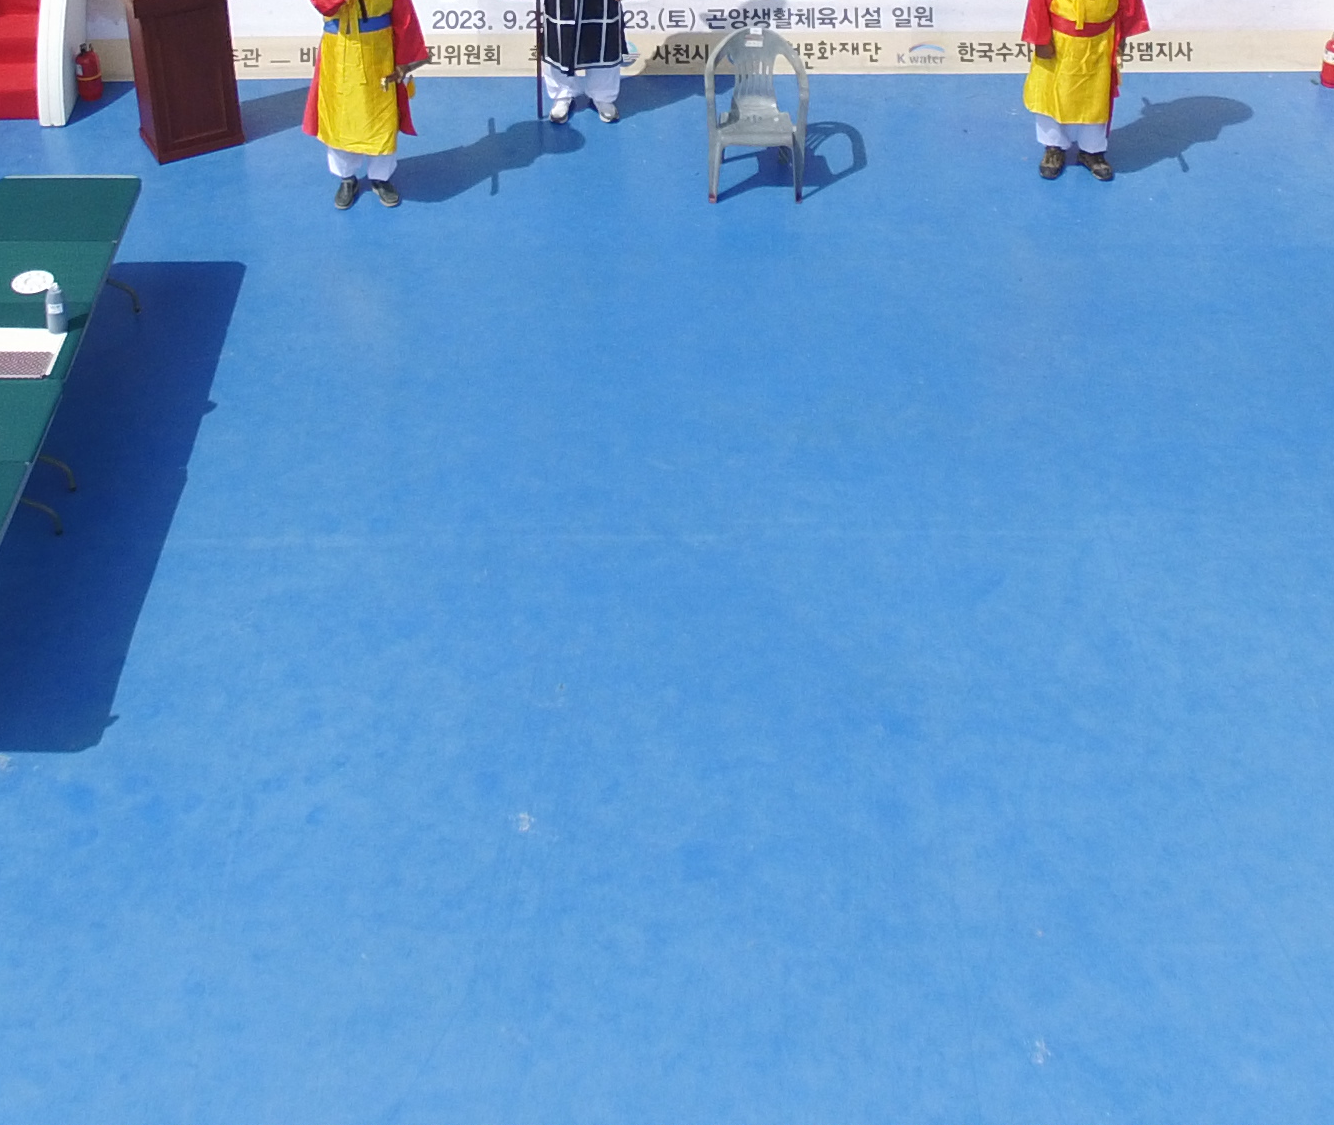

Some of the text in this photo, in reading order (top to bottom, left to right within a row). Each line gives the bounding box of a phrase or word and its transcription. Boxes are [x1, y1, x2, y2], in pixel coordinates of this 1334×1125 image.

[431, 10, 493, 30] 2023.
[705, 8, 882, 29] 곤양생활체육시설
[892, 6, 934, 28] 일원
[653, 44, 709, 65] 사천시
